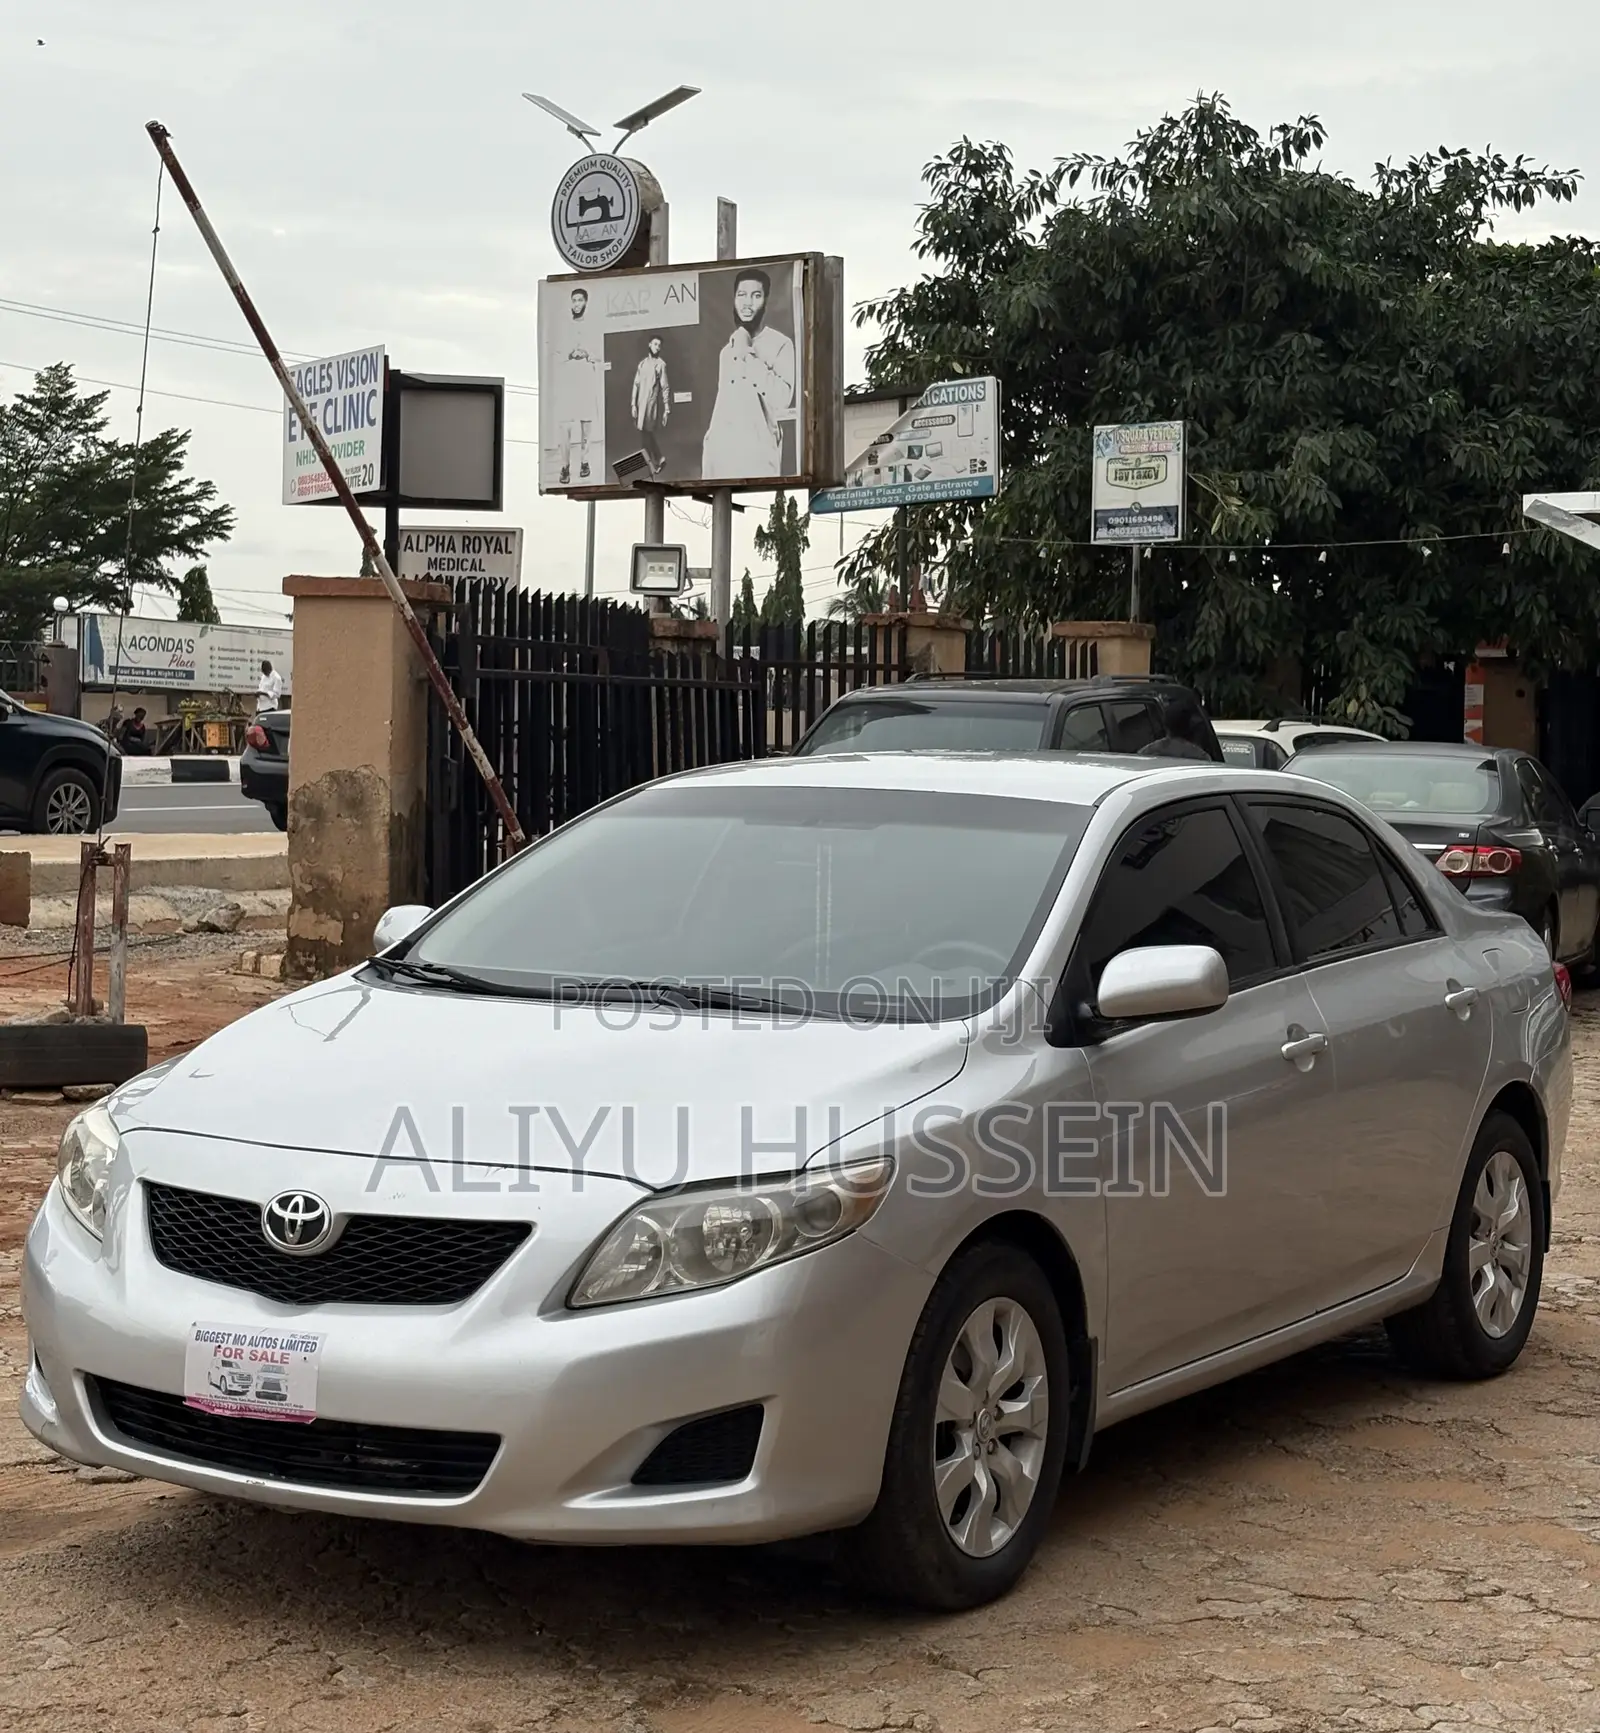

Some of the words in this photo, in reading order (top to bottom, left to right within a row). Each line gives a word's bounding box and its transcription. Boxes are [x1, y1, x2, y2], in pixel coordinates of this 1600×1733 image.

[561, 160, 598, 197] PREMIUM
[599, 160, 632, 188] QUALITY
[566, 244, 598, 264] TAILOR
[600, 238, 624, 262] SHOP
[336, 352, 379, 390] VISION
[323, 389, 377, 435] CLINIC
[362, 462, 374, 487] 20
[908, 482, 931, 493] Gate
[934, 479, 979, 491] Entrance
[403, 534, 457, 554] ALPHA
[461, 535, 513, 555] ROYAL
[427, 557, 486, 573] MEDICAL
[168, 653, 196, 668] Place
[158, 670, 173, 679] Night
[195, 1330, 231, 1344] BIGGEST
[232, 1334, 247, 1346] MO
[248, 1336, 279, 1350] AUTOS
[280, 1338, 317, 1353] LIMITED
[213, 1346, 244, 1361] FOR
[249, 1350, 290, 1365] SALE
